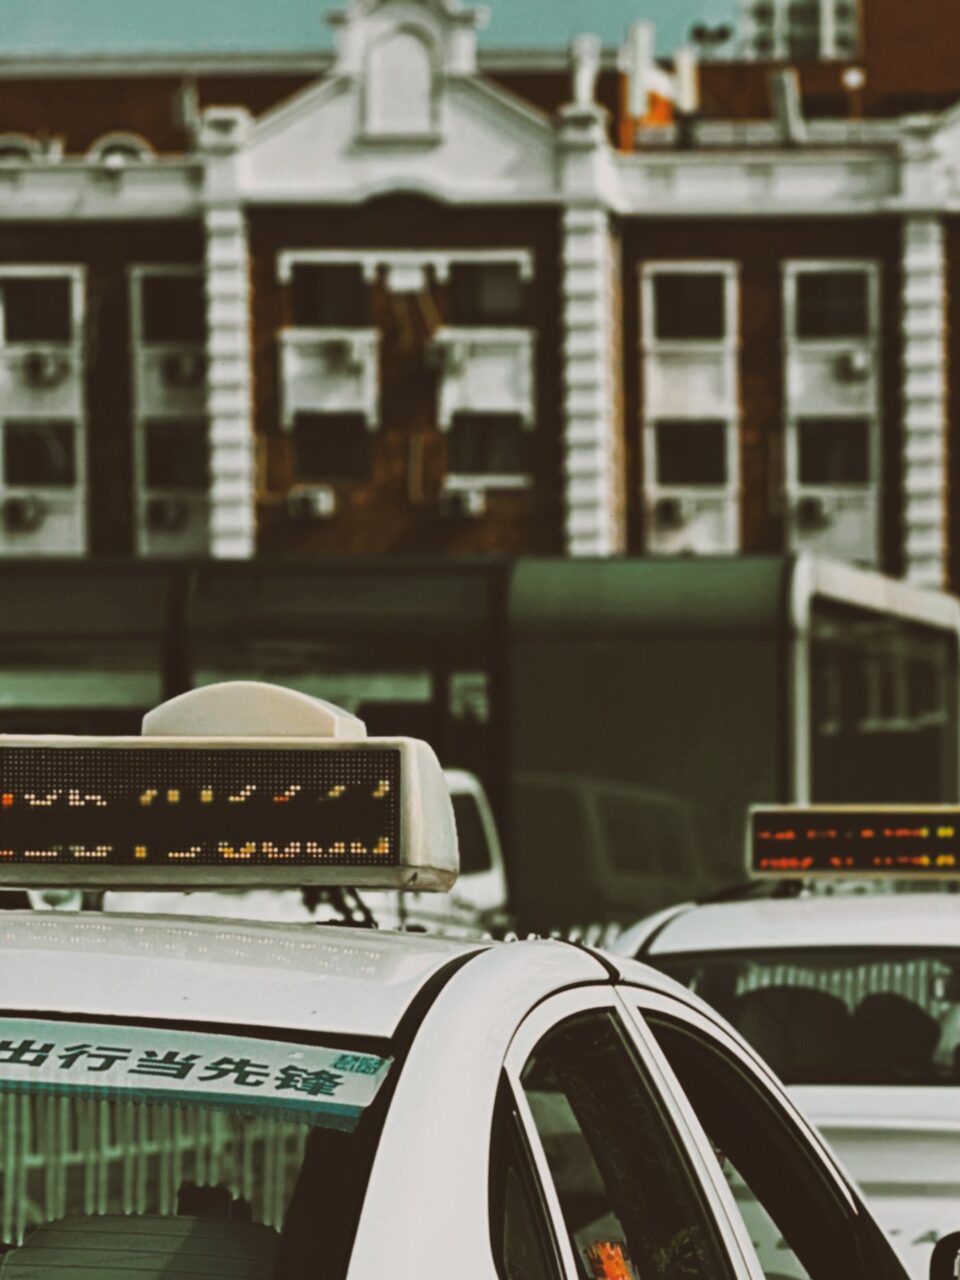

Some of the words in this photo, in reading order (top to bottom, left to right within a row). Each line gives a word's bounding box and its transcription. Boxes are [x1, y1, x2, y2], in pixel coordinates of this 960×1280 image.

[0, 1039, 345, 1096] 出行当先锋
